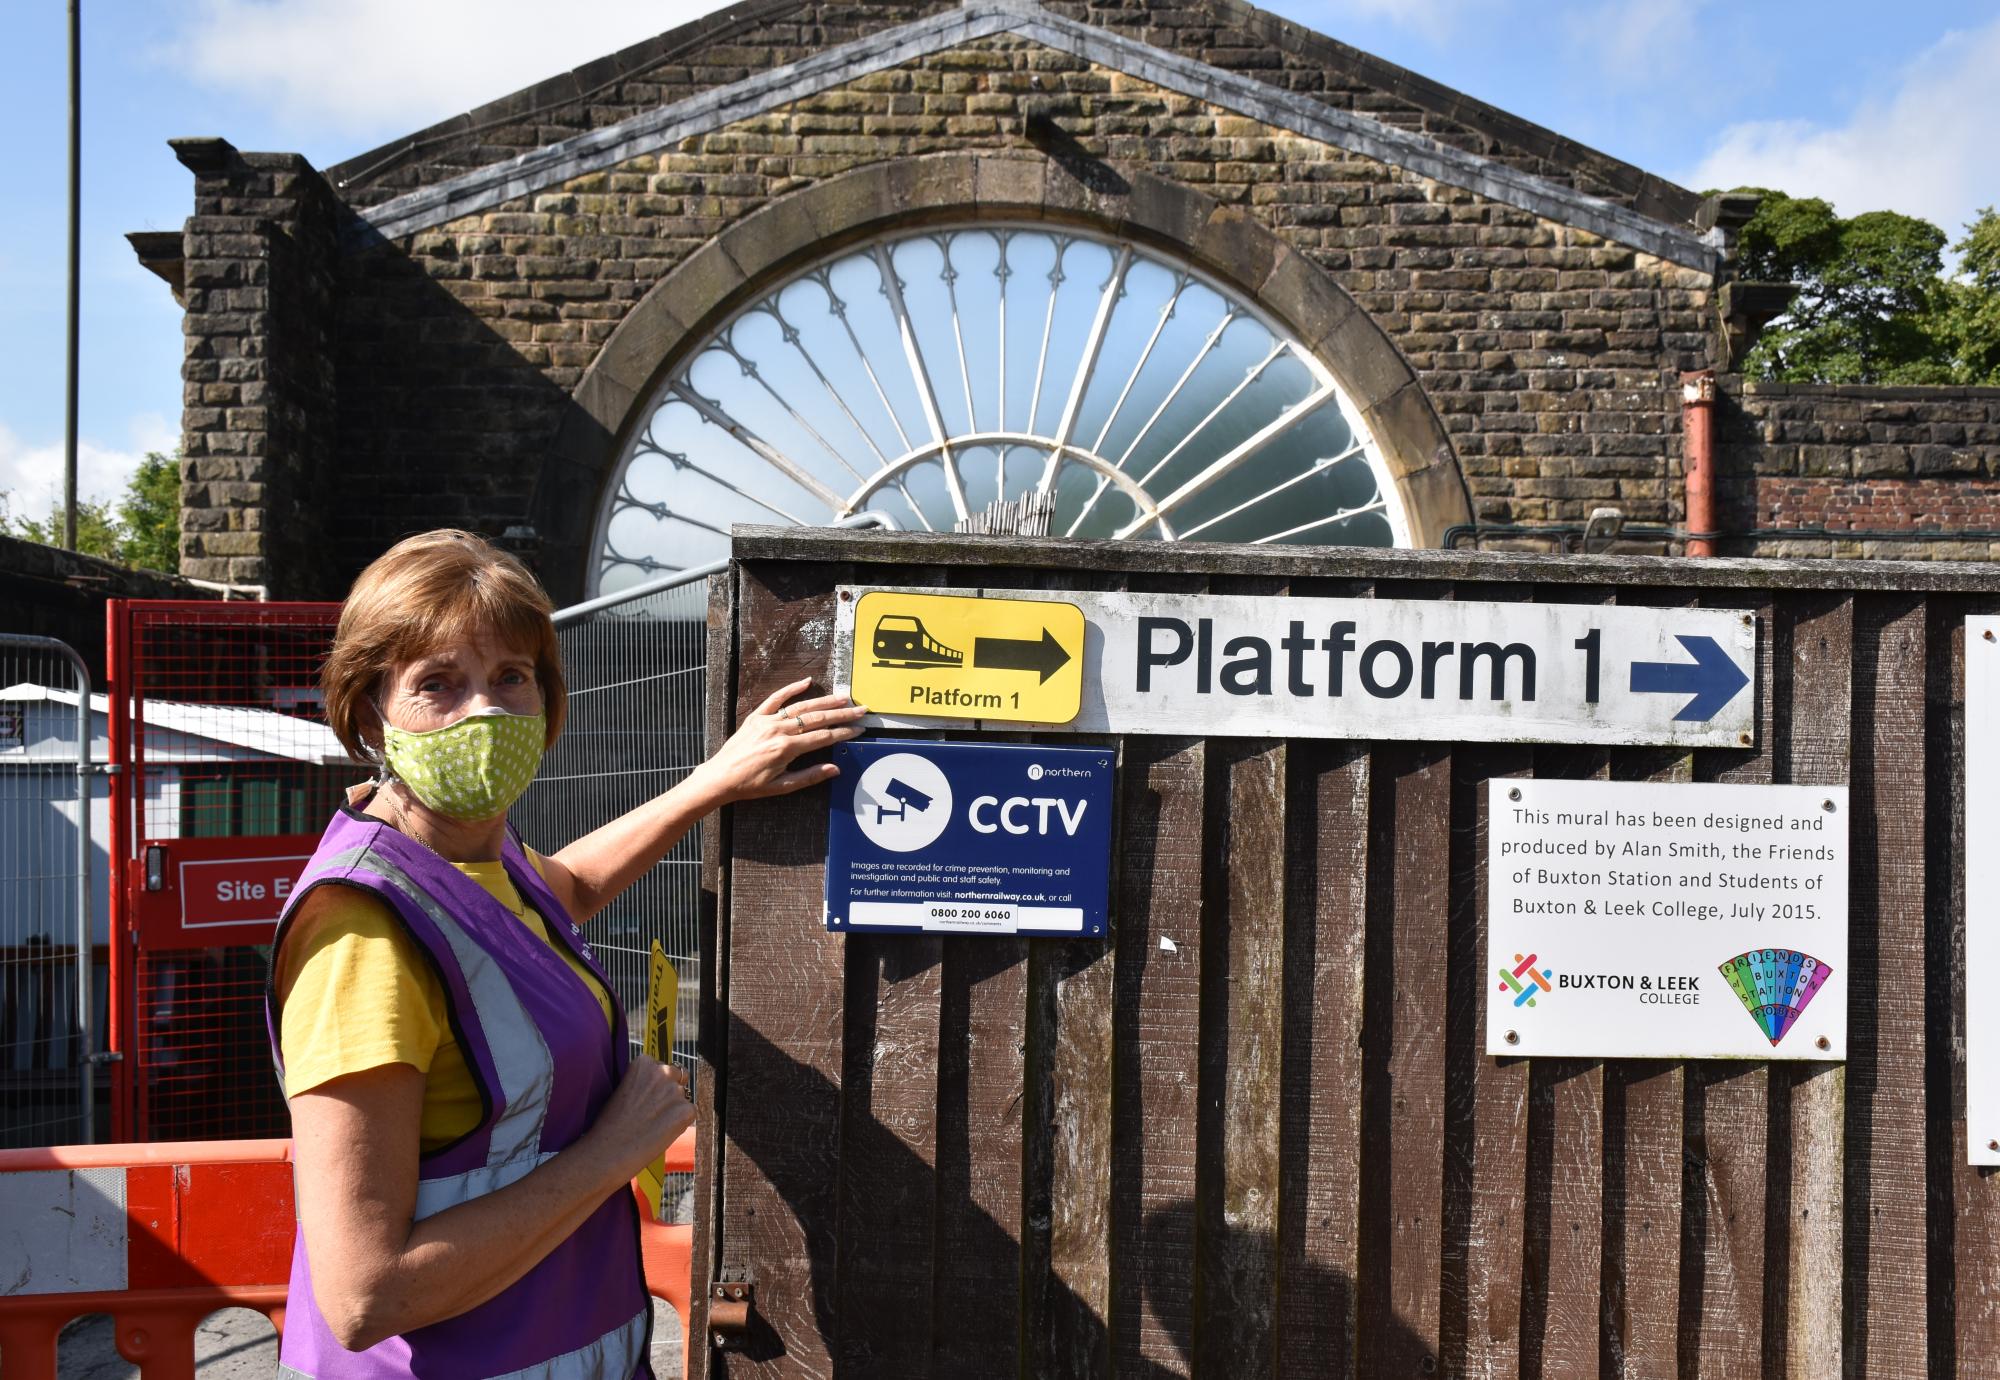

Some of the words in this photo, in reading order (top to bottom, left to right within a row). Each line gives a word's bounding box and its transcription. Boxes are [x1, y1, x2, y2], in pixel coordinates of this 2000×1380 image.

[1135, 616, 1537, 701] Platform
[1574, 628, 1600, 703] 1
[910, 686, 1001, 708] Platform
[1010, 692, 1019, 709] 1
[1044, 768, 1092, 778] northern
[969, 795, 1087, 836] CCTV
[1512, 809, 1550, 824] This
[1557, 810, 1609, 826] mural
[1616, 811, 1646, 826] has
[1653, 812, 1697, 828] been
[1703, 813, 1783, 832] designed
[1790, 816, 1823, 831] and
[1501, 839, 1587, 857] produced
[1595, 840, 1616, 859] by
[1622, 841, 1662, 857] Alan
[1668, 842, 1726, 860] Smith,
[1732, 843, 1762, 859] the
[1769, 845, 1835, 861] Friends
[850, 872, 899, 882] investigation
[900, 874, 916, 882] and
[917, 874, 941, 883] public
[942, 875, 958, 883] and
[959, 875, 977, 884] staff
[977, 876, 1002, 886] safety.
[851, 861, 880, 871] Images
[896, 863, 931, 871] recorded
[944, 864, 967, 872] crime
[968, 866, 1010, 875] prevention,
[1012, 867, 1053, 876] monitoring
[1054, 868, 1071, 876] and
[1512, 868, 1532, 884] of
[1537, 869, 1601, 885] Buxton
[1608, 870, 1672, 887] Station
[1679, 872, 1712, 888] and
[1718, 873, 1798, 890] Students
[1804, 874, 1824, 890] of
[217, 880, 266, 901] Site
[850, 888, 862, 896] For
[864, 888, 890, 897] further
[891, 889, 935, 898] information
[936, 890, 953, 898] visit:
[954, 891, 1047, 902] northernrailway.co.uk,
[1058, 893, 1072, 902] call
[931, 908, 958, 918] 0800
[961, 910, 981, 918] 200
[984, 910, 1011, 919] 6060
[1513, 898, 1576, 914] Buxton
[1583, 899, 1597, 915] &
[1605, 900, 1645, 916] Leek
[1652, 901, 1724, 921] College,
[1730, 902, 1765, 922] July
[1771, 904, 1821, 920] 2015.
[1722, 950, 1815, 974] FRIENDS
[652, 963, 664, 1021] Train
[1558, 974, 1634, 989] BUXTON
[1640, 976, 1653, 990] &
[1658, 976, 1700, 991] LEEK
[1639, 993, 1700, 1005] COLLEGE
